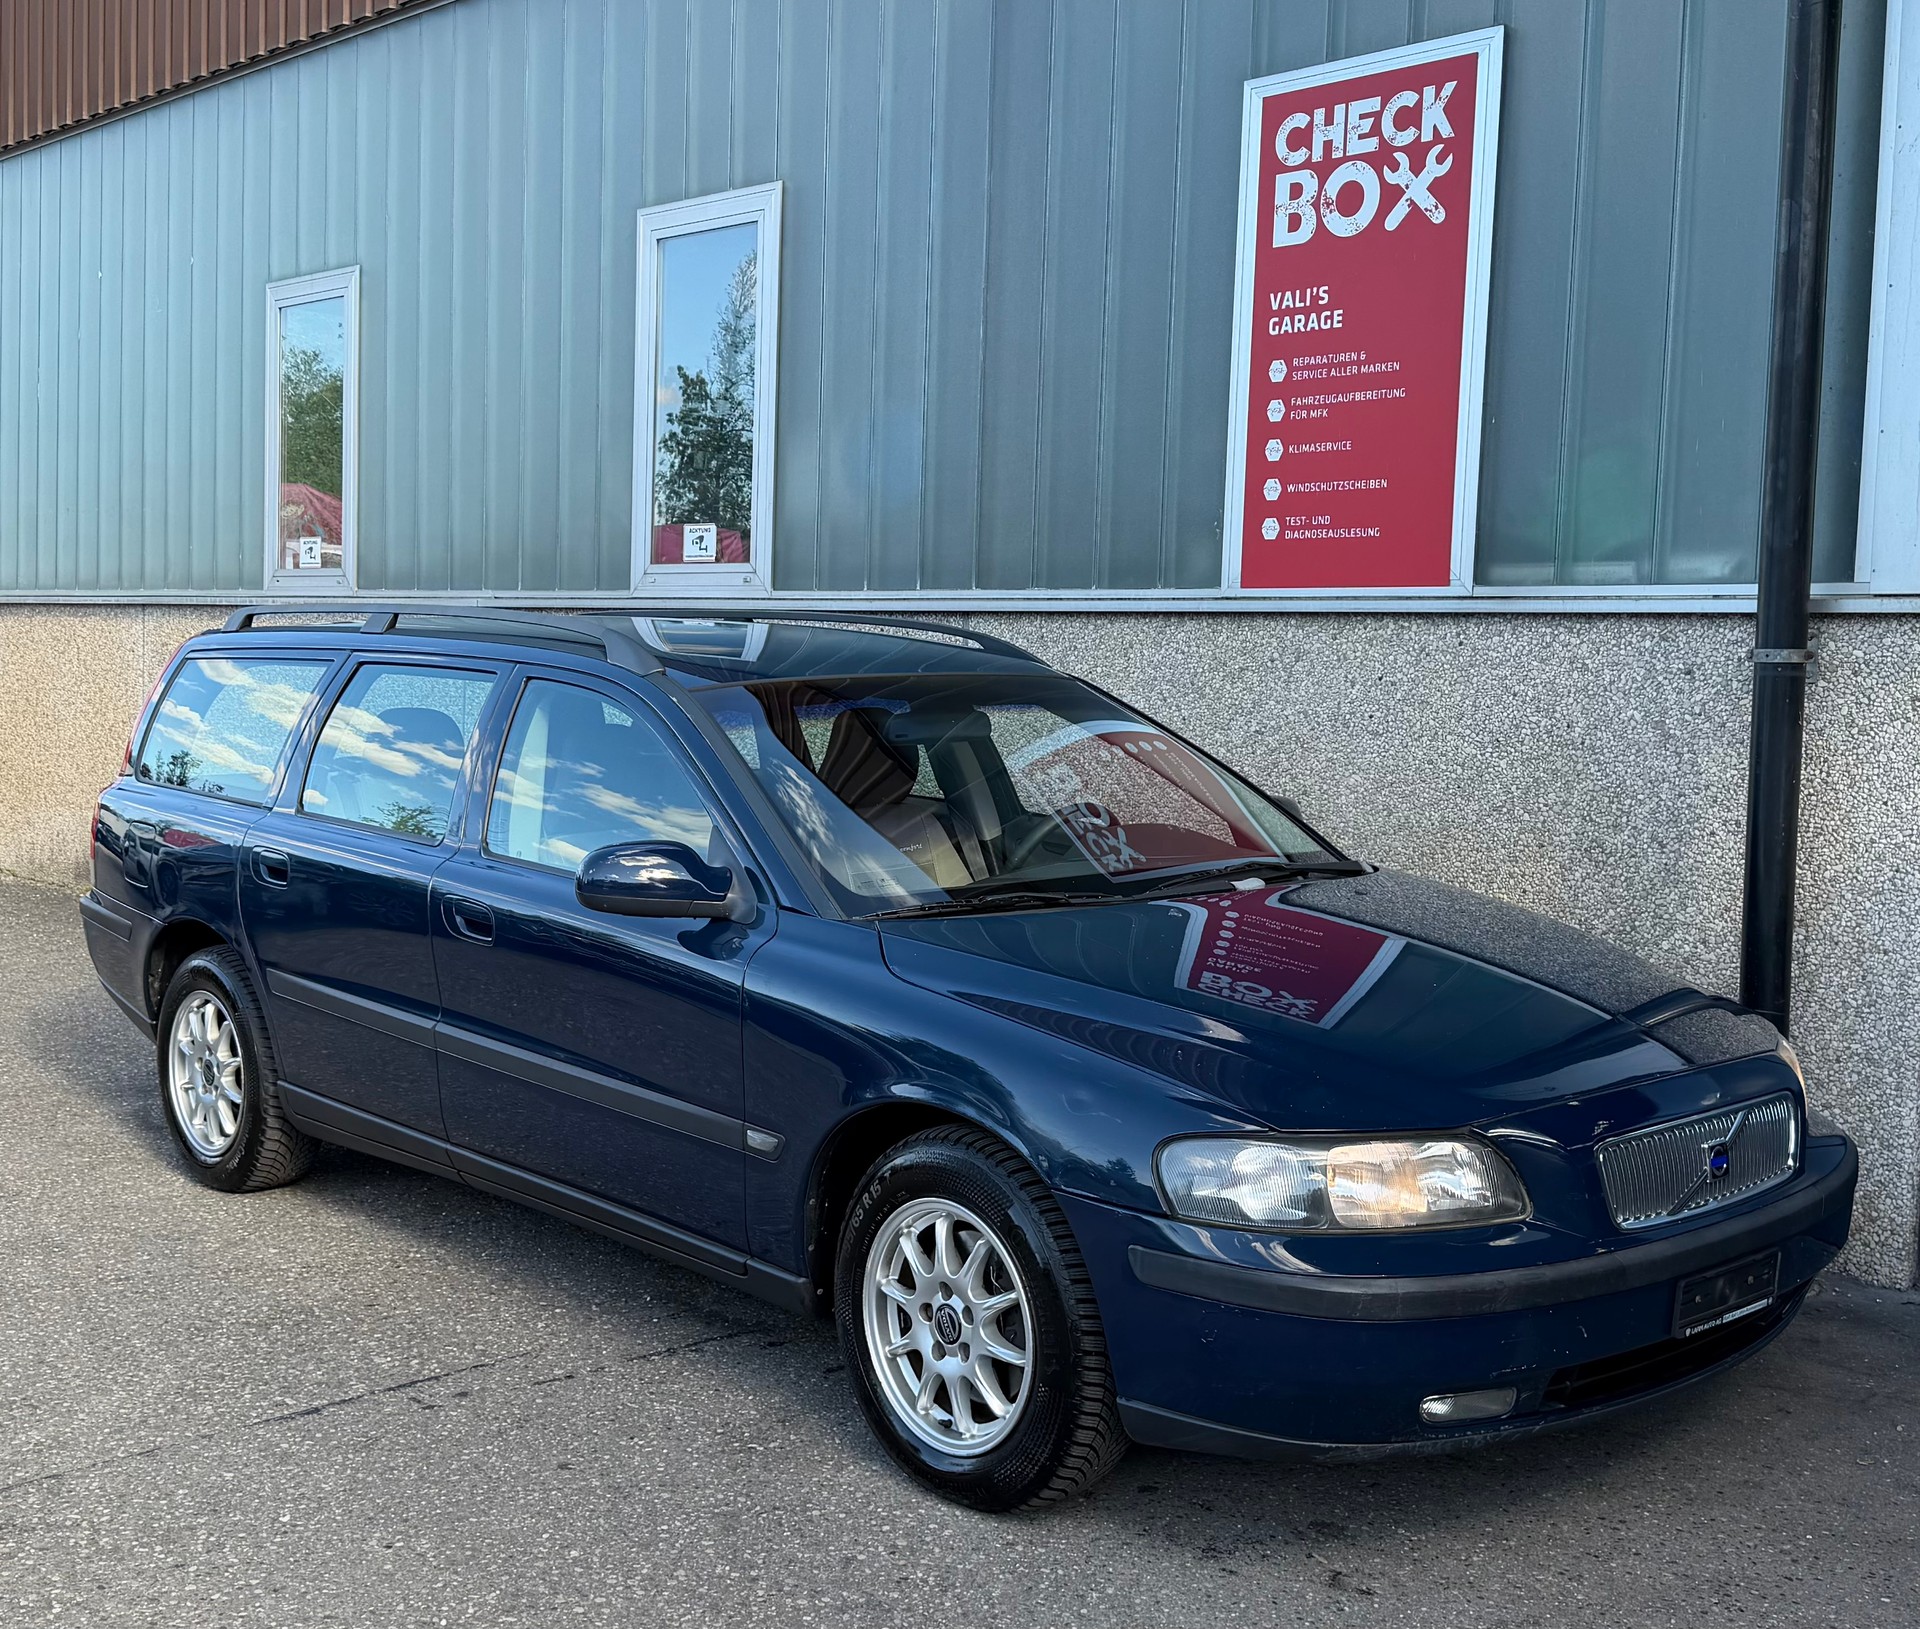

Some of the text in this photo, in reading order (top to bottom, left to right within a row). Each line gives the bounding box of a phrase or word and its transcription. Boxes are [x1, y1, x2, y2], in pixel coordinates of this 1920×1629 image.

[1275, 80, 1458, 166] CHECK
[1273, 144, 1453, 248] BOX
[1268, 309, 1344, 336] GARAGE
[1292, 351, 1367, 367] REPARATUREN &
[1292, 361, 1400, 381] SERVICE ALLER MARKEN
[1290, 387, 1406, 406] FAHRZEUGAUFBEREITUNG
[1309, 408, 1329, 419] MFK
[1288, 440, 1352, 454] KLIMASERVICE
[1286, 478, 1388, 493] WINDSCHUTZSCHEIBEN
[1285, 515, 1331, 526] TEST- UND
[1284, 527, 1381, 540] DIAGNOSEAUSLESUNG
[862, 1192, 873, 1209] R
[870, 1179, 882, 1199] 15
